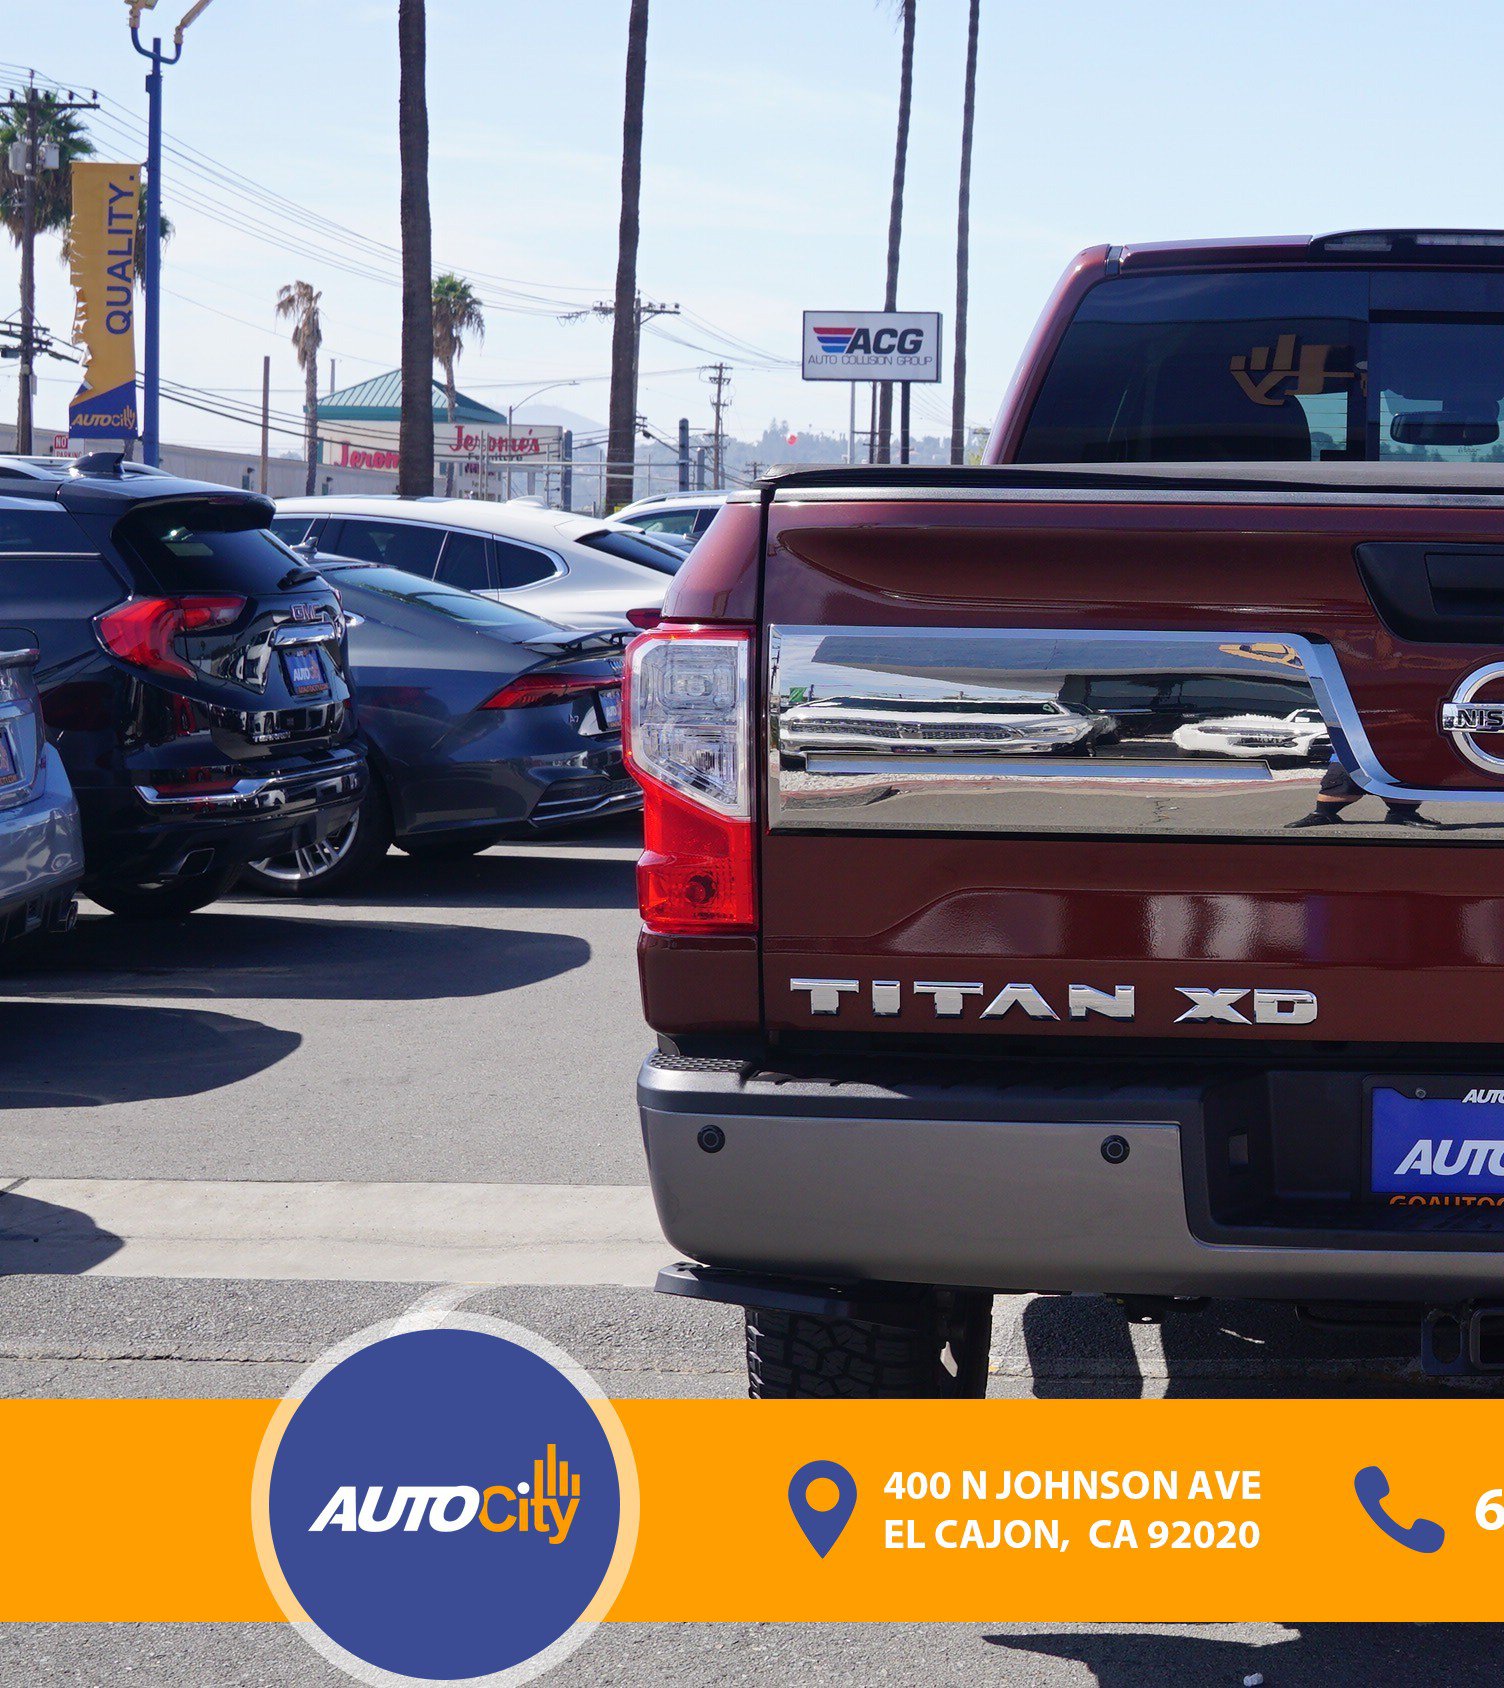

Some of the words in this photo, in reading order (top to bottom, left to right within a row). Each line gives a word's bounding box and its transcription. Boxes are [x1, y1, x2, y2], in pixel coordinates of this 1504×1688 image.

[106, 175, 134, 334] QUALITY.
[845, 328, 924, 354] ACG
[808, 354, 838, 365] AUTO
[842, 355, 893, 365] COLLISION
[897, 356, 933, 366] GROUP
[56, 436, 67, 448] NO
[334, 440, 400, 469] Jerom
[292, 604, 323, 620] GMC
[790, 978, 1136, 1022] TITAN
[1173, 987, 1319, 1025] XD
